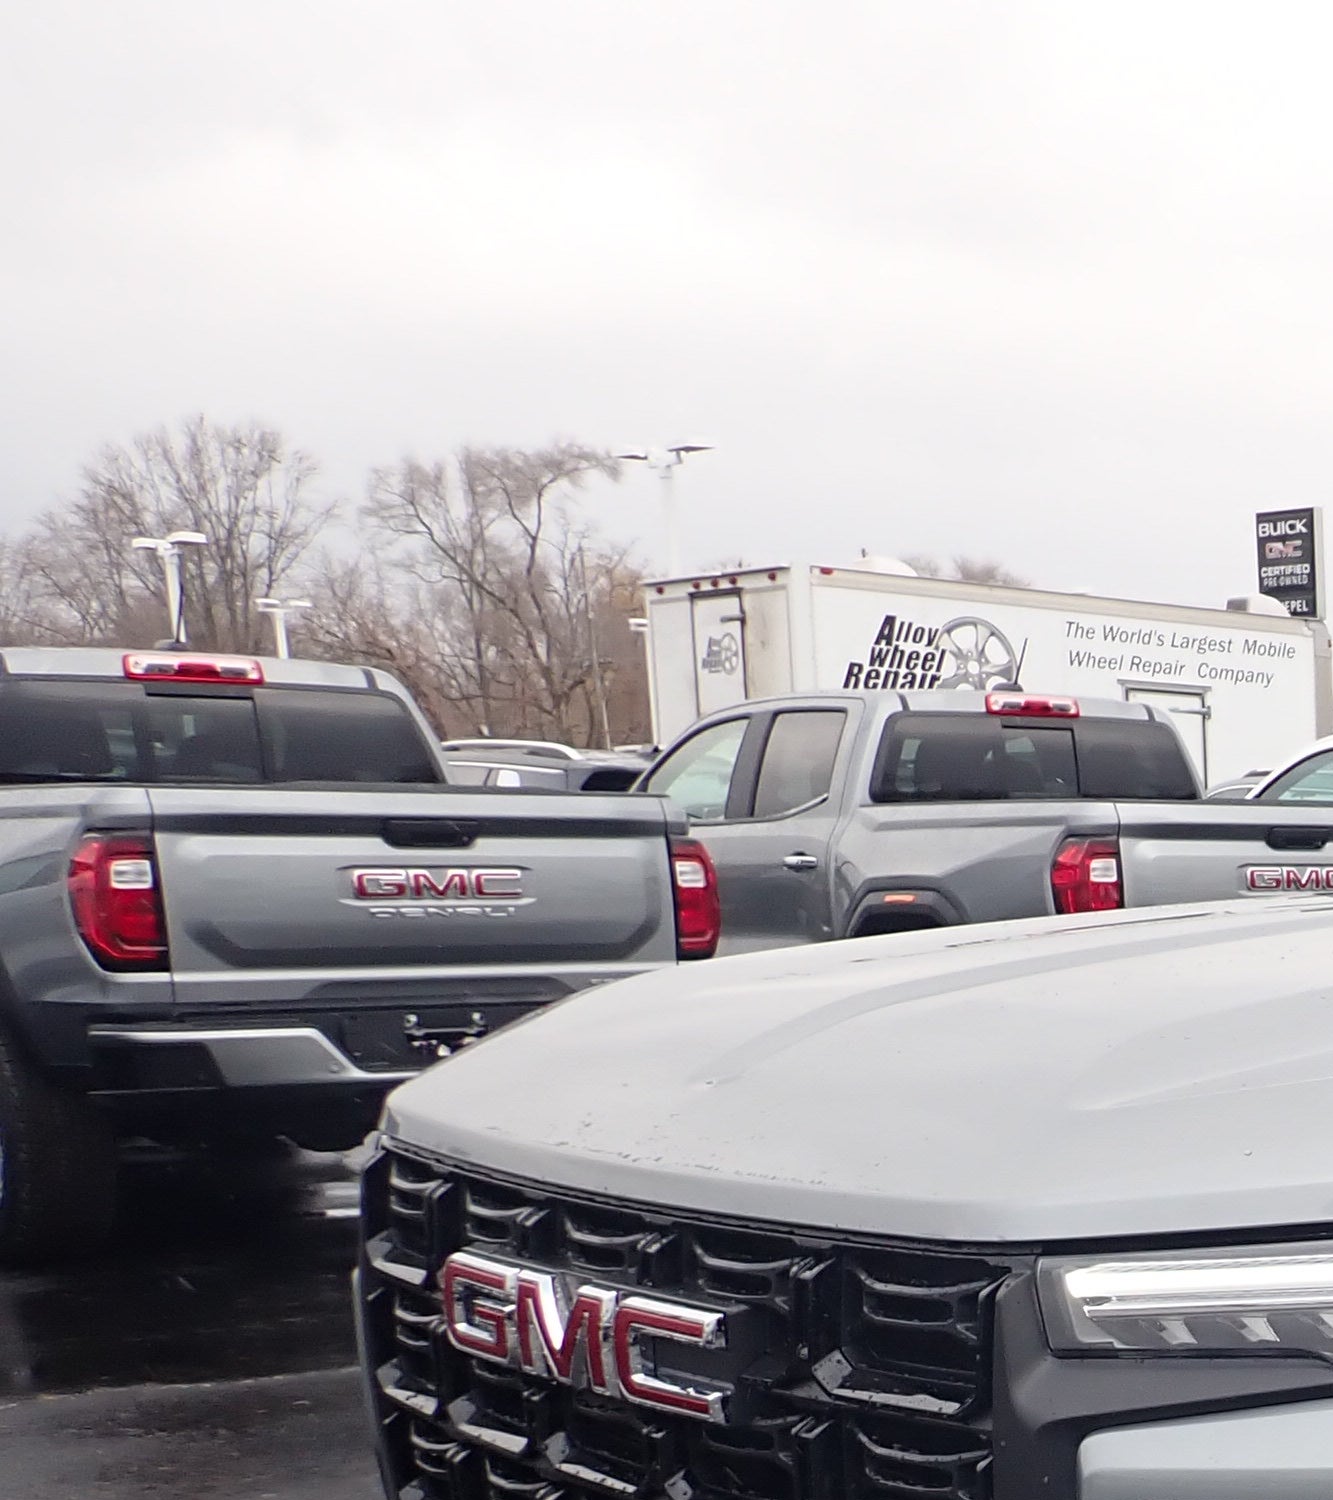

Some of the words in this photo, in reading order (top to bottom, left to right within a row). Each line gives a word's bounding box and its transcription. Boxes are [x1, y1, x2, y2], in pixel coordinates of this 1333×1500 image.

[1258, 518, 1308, 537] BUICK
[1261, 563, 1310, 577] CERTIFIED
[874, 614, 940, 647] Alloy
[1065, 621, 1095, 640] The
[1102, 624, 1165, 647] World's
[1171, 632, 1232, 654] Largest
[1242, 638, 1296, 660] Mobile
[1068, 650, 1124, 671] Wheel
[1129, 655, 1186, 677] Repair
[1197, 662, 1274, 688] Company
[353, 868, 523, 899] GMC
[440, 1251, 730, 1425] GMC
